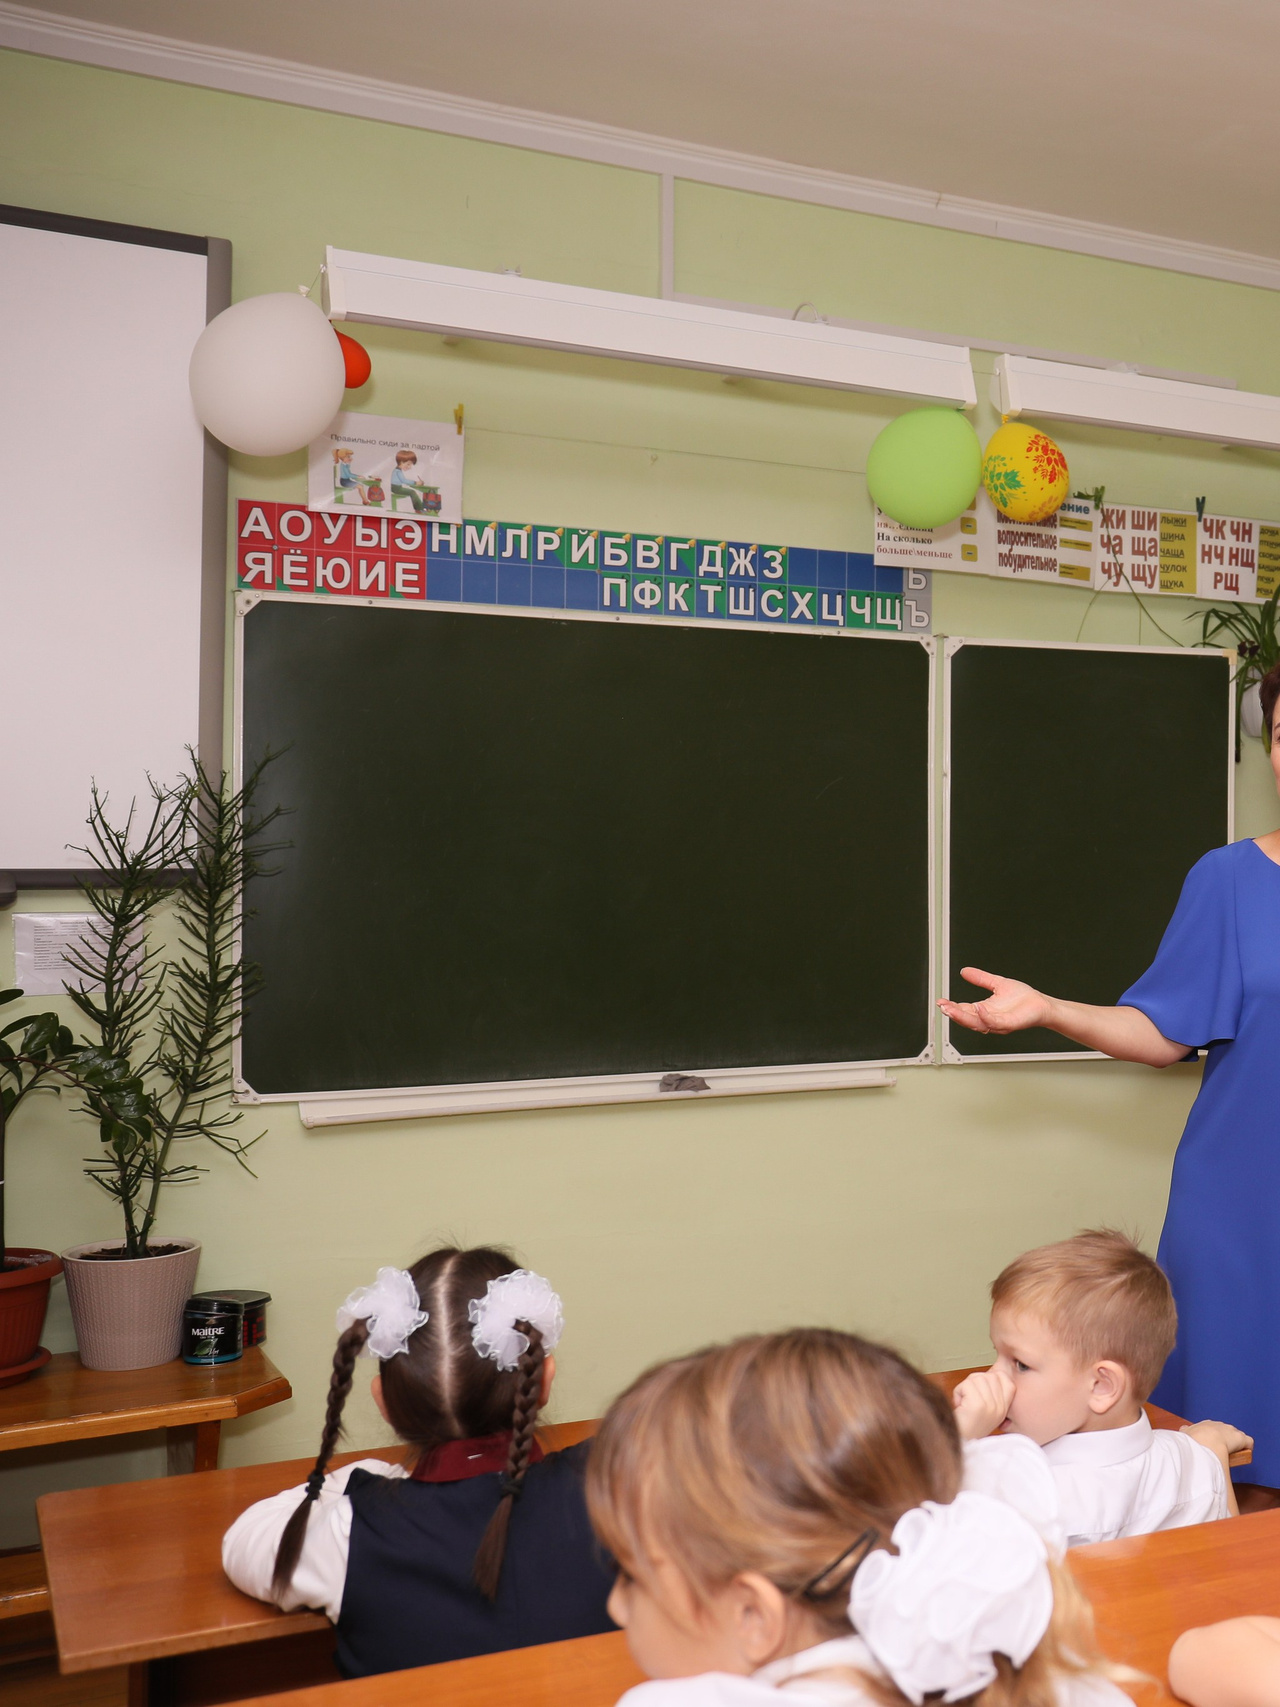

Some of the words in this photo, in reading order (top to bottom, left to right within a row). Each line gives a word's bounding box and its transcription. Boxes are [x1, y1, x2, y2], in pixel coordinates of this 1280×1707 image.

[331, 434, 376, 445] Правильно
[378, 440, 398, 448] сиди
[1160, 516, 1187, 525] ЛЫЖИ
[1160, 532, 1185, 541] ШИНА
[1203, 518, 1226, 540] ЧК
[1230, 521, 1252, 543] ЧН
[877, 532, 890, 541] На
[893, 535, 932, 544] сколько
[997, 529, 1057, 551] вопросительное
[1160, 548, 1185, 557] ЧАЩА
[1201, 544, 1224, 565] НЧ
[1228, 547, 1255, 574] НЩ
[998, 550, 1057, 573] побудительное
[1160, 564, 1187, 573] ЧУЛОК
[1160, 580, 1184, 588] ЩУКА
[1213, 572, 1239, 595] РЩ
